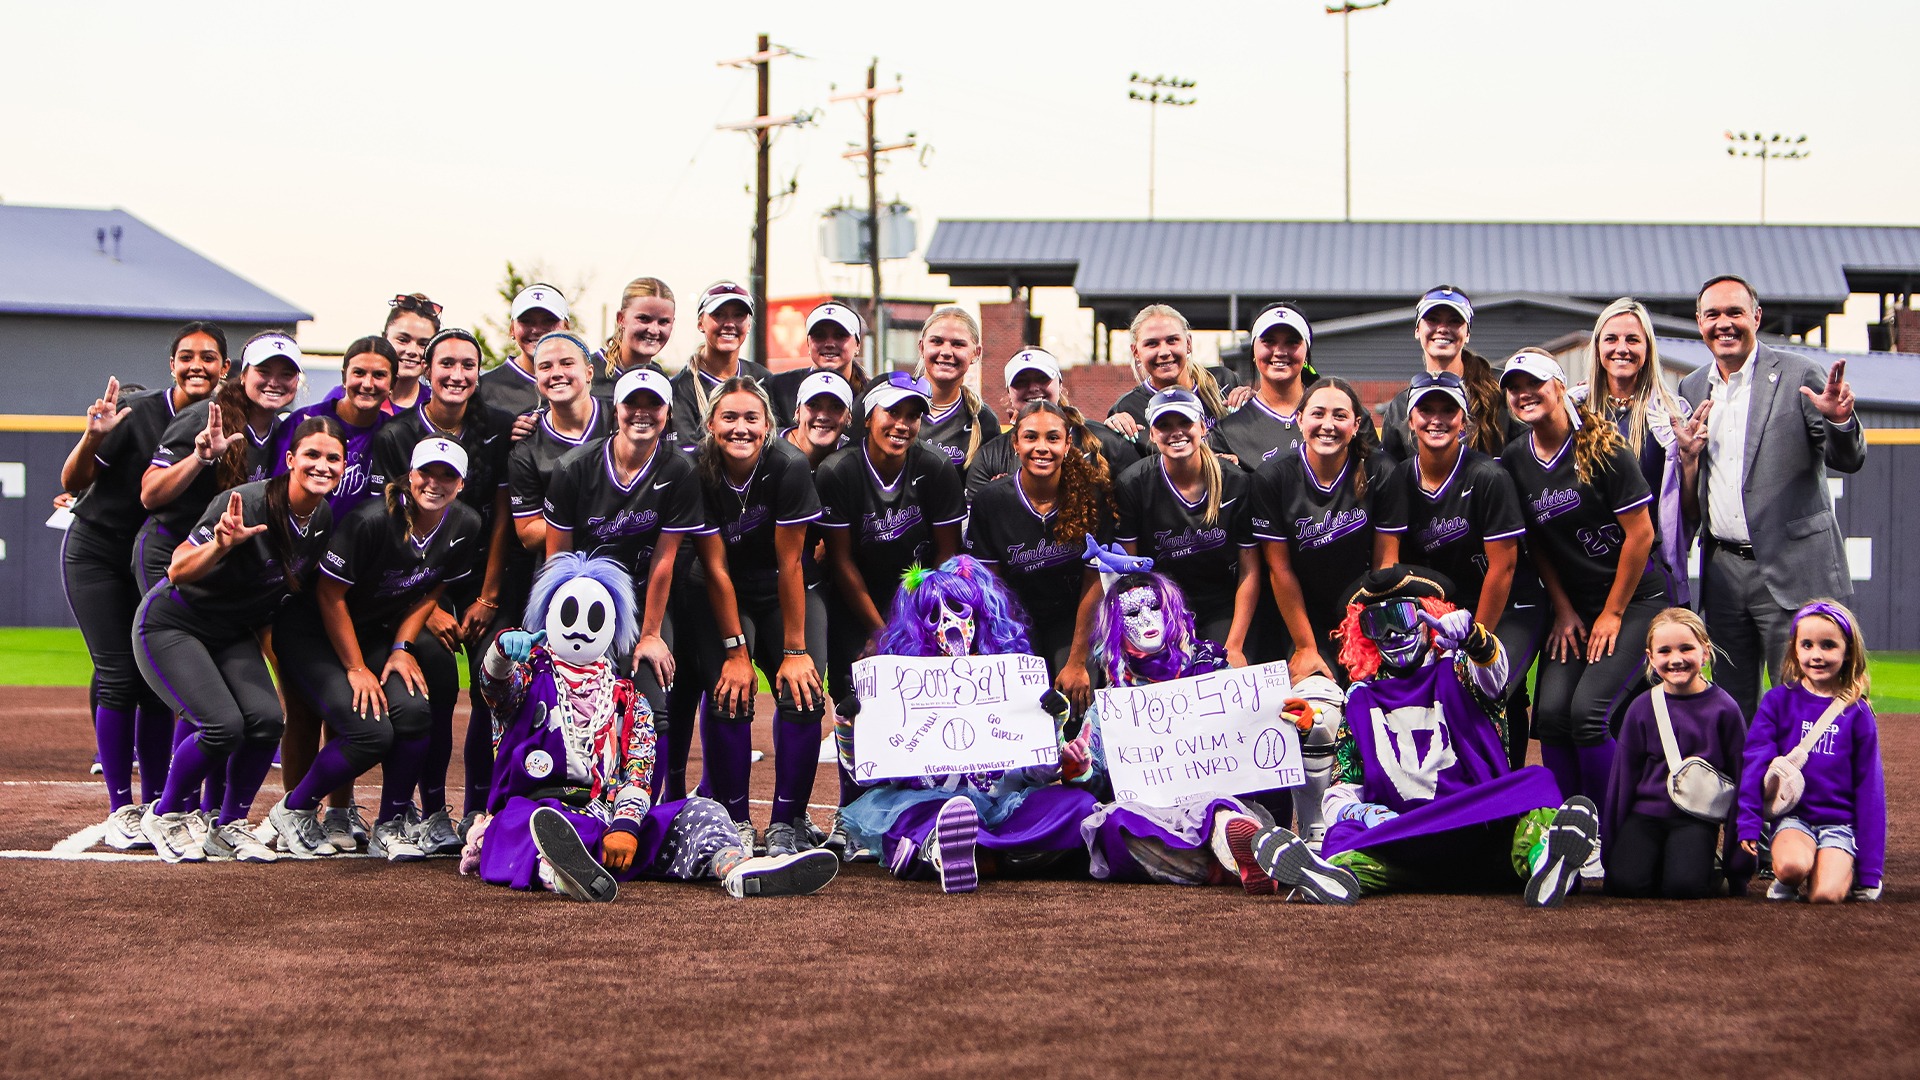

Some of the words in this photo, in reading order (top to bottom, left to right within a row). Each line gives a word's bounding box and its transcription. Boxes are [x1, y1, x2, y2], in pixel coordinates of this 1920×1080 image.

[1294, 507, 1366, 540] Tarleton
[1154, 526, 1226, 550] Tarleton
[1312, 533, 1334, 547] STATE
[326, 550, 346, 567] WAC
[1171, 547, 1192, 558] STATE
[1024, 561, 1045, 572] STATE
[1017, 655, 1044, 670] 1923
[1263, 663, 1286, 674] 1923
[1020, 673, 1046, 686] 1921
[1264, 677, 1285, 688] 1921
[991, 727, 1024, 743] GIRLZ!
[1031, 745, 1058, 764] TTS
[1143, 766, 1175, 786] HIT
[1274, 768, 1301, 786] TTS
